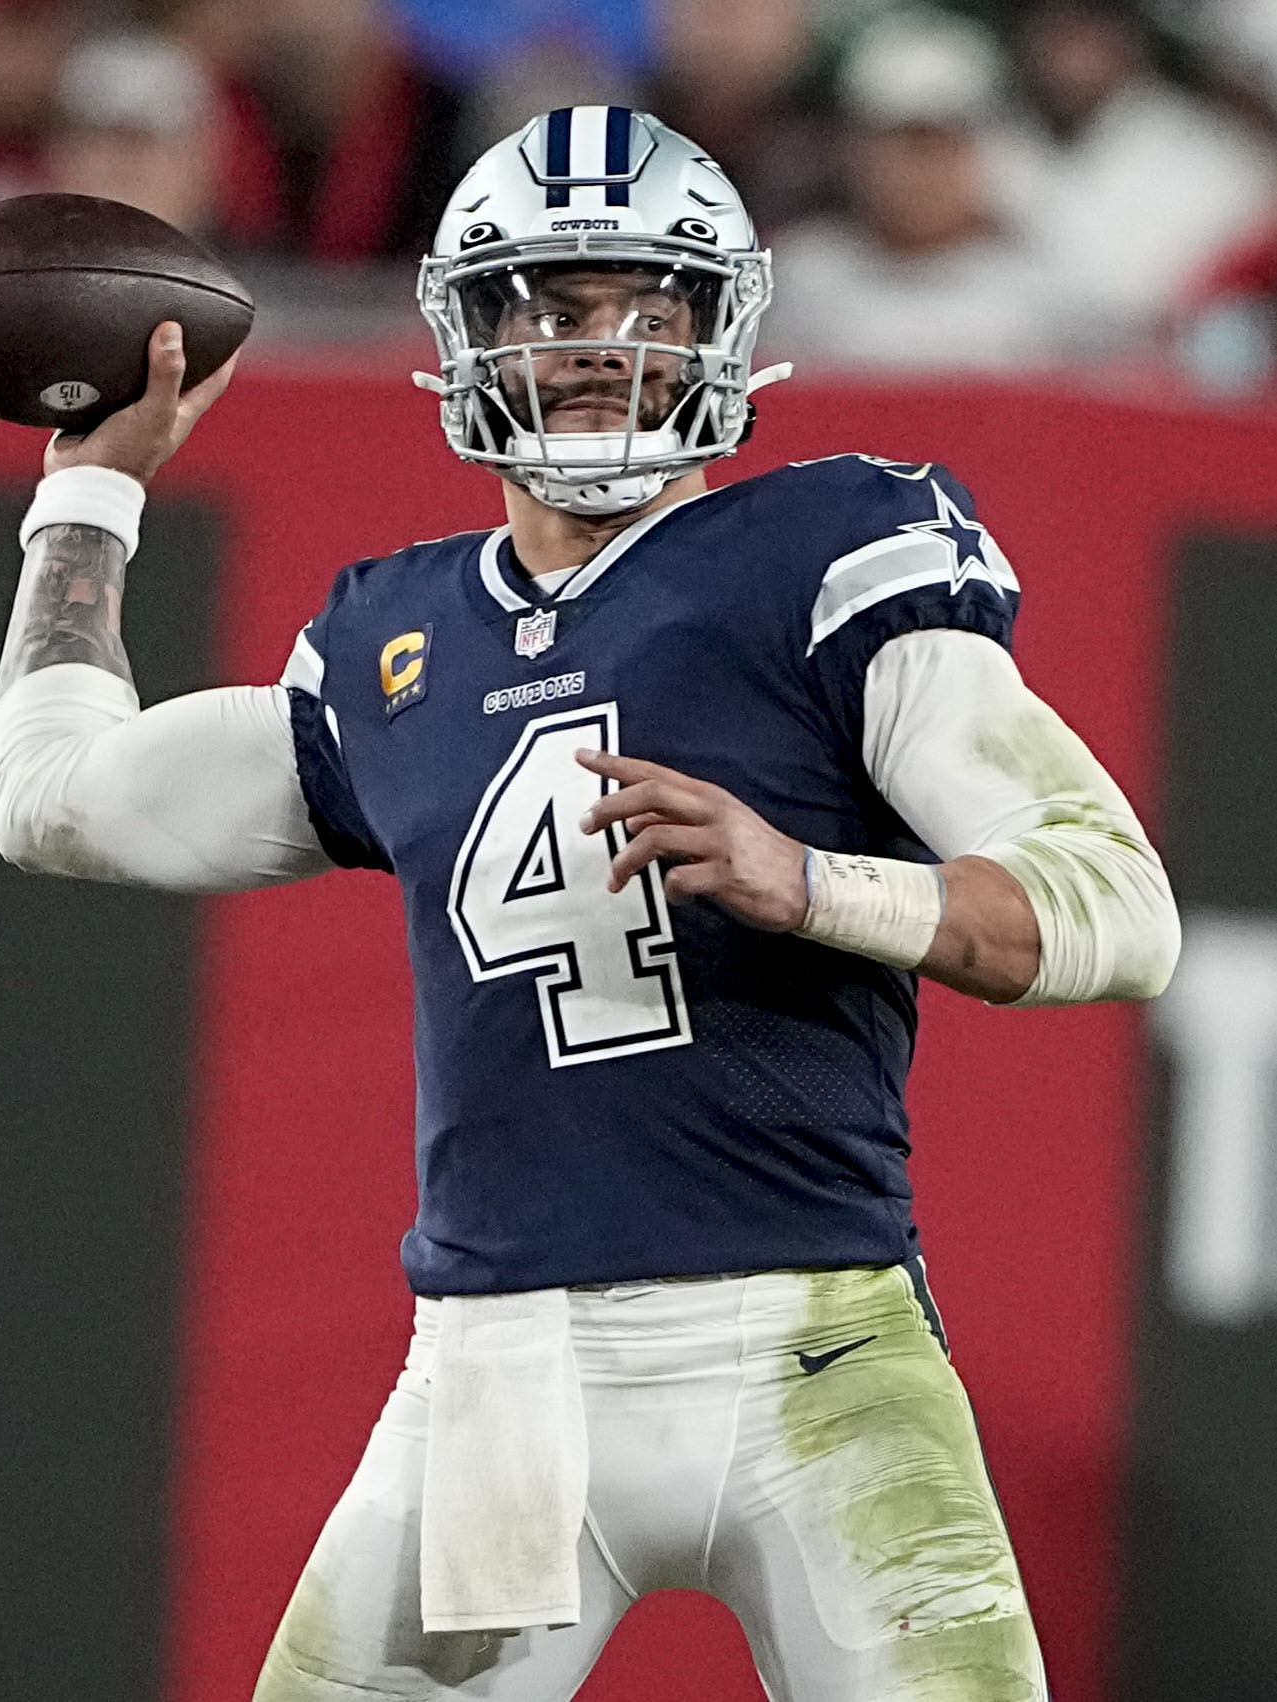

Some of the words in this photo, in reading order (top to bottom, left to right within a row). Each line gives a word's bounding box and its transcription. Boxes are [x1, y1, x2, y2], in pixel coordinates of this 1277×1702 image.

[551, 219, 619, 231] COWBOYS
[59, 384, 82, 399] 115
[379, 630, 426, 697] C
[483, 671, 586, 715] COWBOYS
[446, 700, 694, 1069] 4
